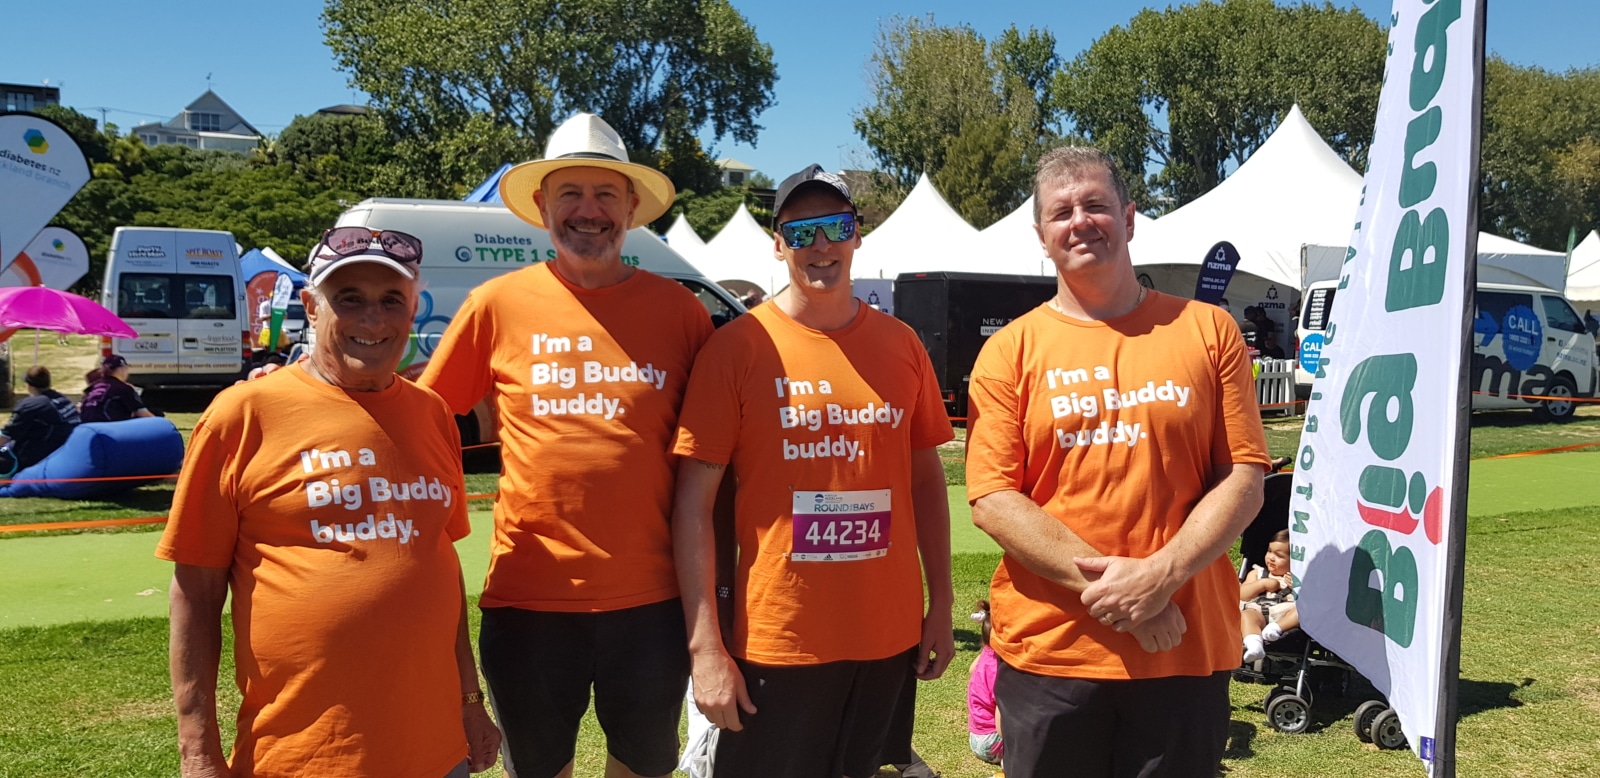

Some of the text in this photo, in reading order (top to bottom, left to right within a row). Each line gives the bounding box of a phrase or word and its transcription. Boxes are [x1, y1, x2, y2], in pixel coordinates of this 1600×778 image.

[0, 149, 61, 176] diabetes nz
[474, 233, 532, 245] Diabetes
[475, 247, 526, 262] TYPE
[531, 249, 541, 262] 1
[1207, 261, 1231, 271] nzma
[982, 318, 1004, 326] NEW
[1508, 315, 1538, 335] CALL
[532, 333, 593, 355] I'm a
[1303, 342, 1321, 352] CAL
[532, 361, 667, 390] Big Buddy
[775, 377, 832, 398] I'm a
[1046, 365, 1110, 389] I'm a
[532, 393, 625, 420] buddy.
[1050, 380, 1190, 419] Big Buddy
[779, 402, 904, 431] Big Buddy
[1056, 421, 1147, 448] buddy.
[300, 447, 376, 473] I'm a
[783, 435, 865, 462] buddy.
[306, 476, 452, 510] Big Buddy
[814, 503, 849, 512] ROUND
[853, 502, 875, 511] BAYS
[310, 513, 420, 544] buddy.
[805, 519, 881, 545] 44234
